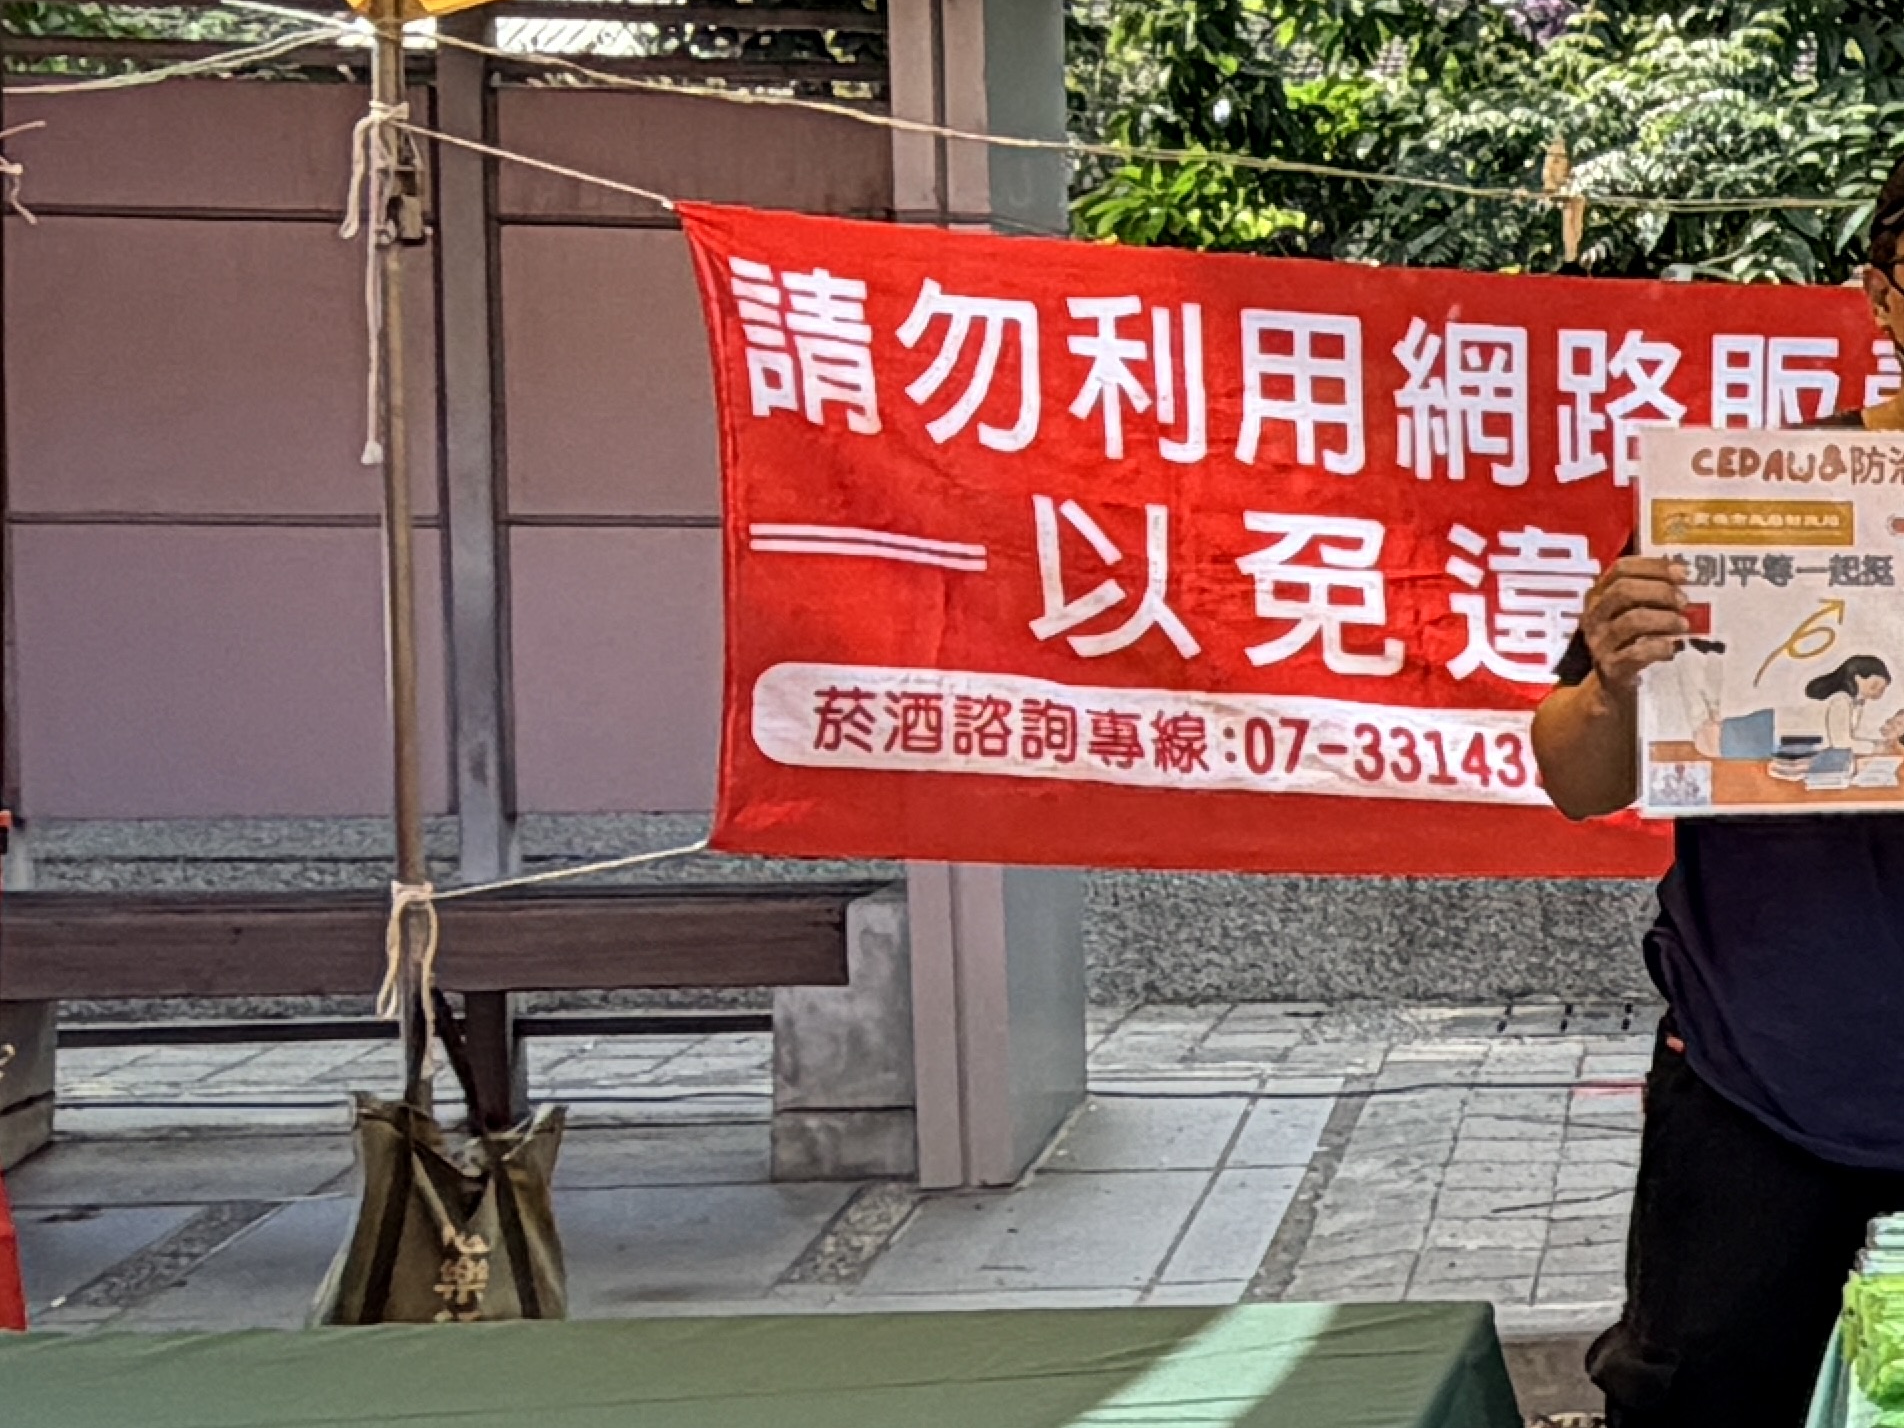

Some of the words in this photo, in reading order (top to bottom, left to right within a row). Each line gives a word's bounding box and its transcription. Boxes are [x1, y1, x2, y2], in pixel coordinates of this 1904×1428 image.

[813, 685, 1546, 790] 菸酒諮詢專線:07-33143
